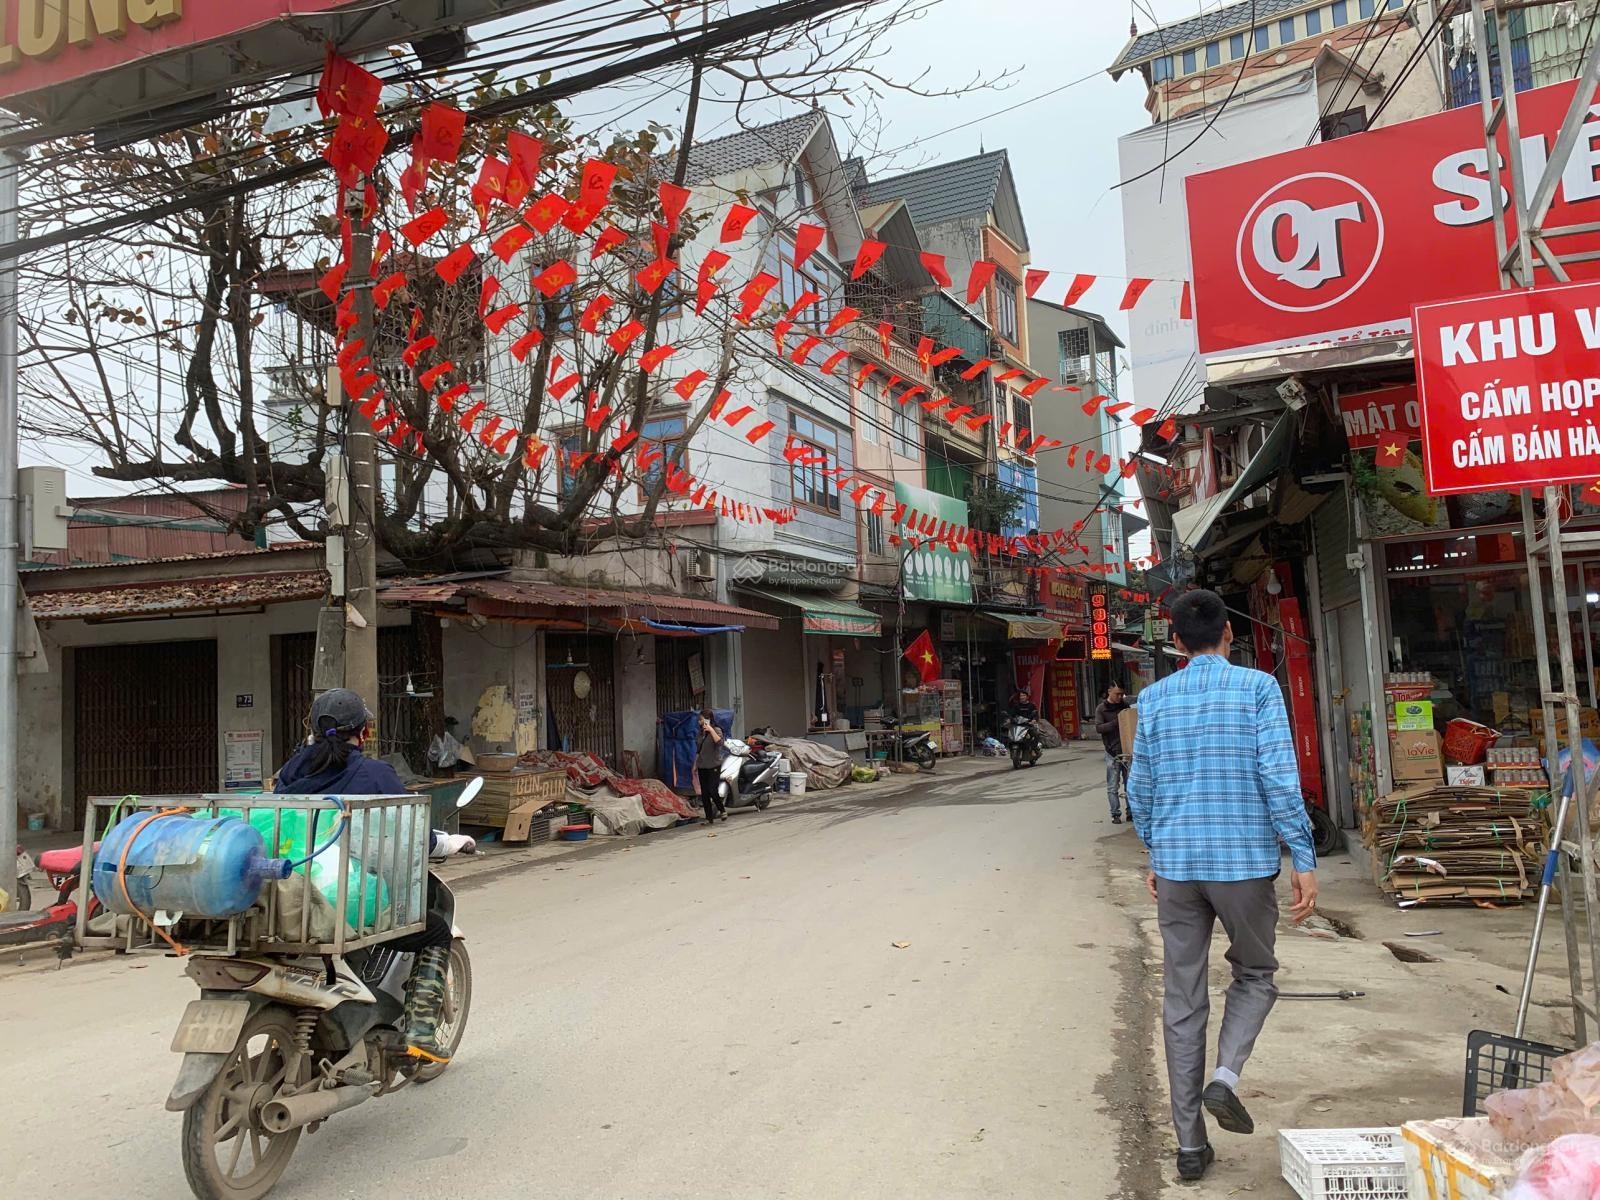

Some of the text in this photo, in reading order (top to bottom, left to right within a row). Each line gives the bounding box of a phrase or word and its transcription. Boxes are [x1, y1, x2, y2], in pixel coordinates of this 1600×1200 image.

[1439, 312, 1557, 367] KHU
[1460, 378, 1600, 421] CẤM HỌP
[1452, 428, 1506, 469] CẤM
[1511, 424, 1562, 463] BÁN
